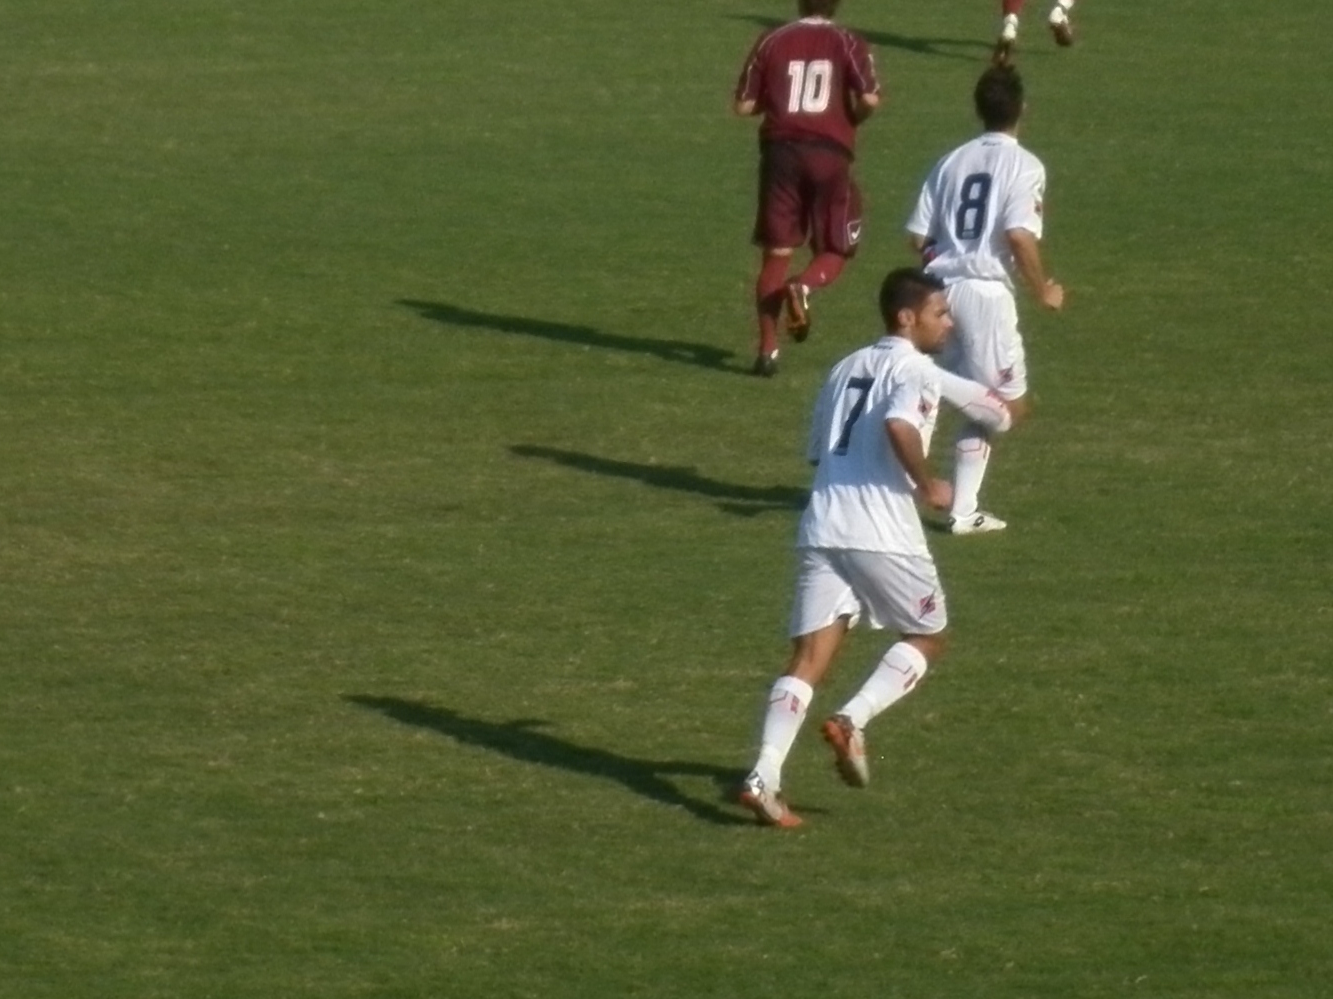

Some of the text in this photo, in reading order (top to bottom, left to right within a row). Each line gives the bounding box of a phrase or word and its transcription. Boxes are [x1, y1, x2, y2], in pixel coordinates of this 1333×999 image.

[787, 59, 834, 114] 10
[955, 172, 992, 241] 8
[833, 376, 876, 456] 7
